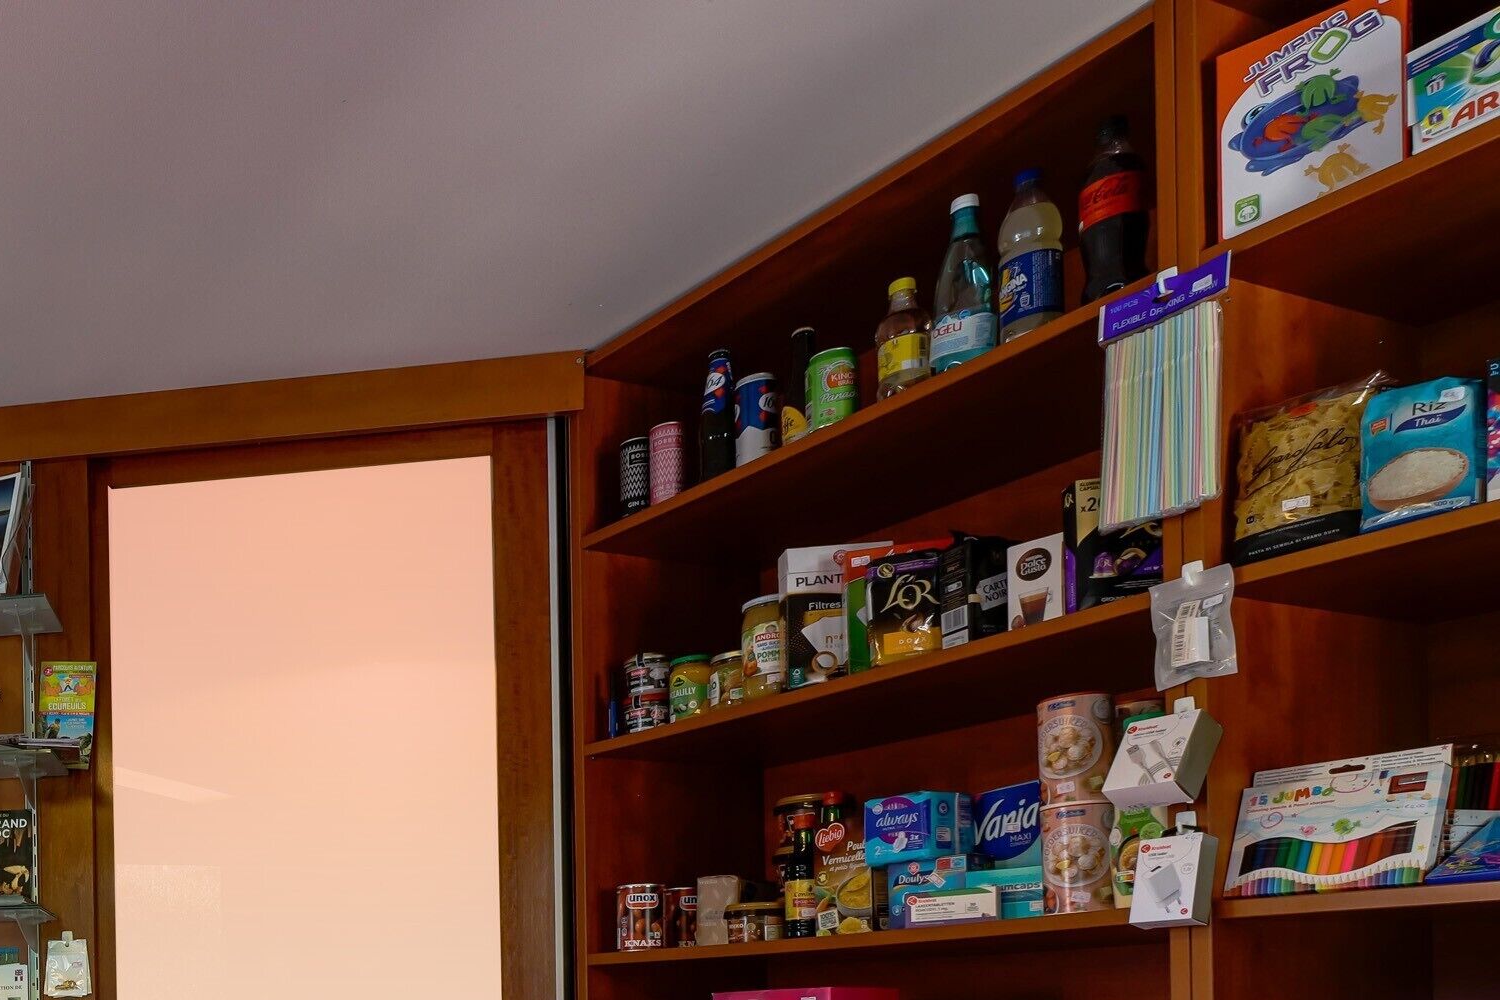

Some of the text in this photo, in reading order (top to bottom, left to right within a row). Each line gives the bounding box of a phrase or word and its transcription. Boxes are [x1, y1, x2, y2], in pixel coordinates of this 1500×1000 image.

[1245, 12, 1347, 81] JUMPING
[1257, 9, 1384, 97] FROG
[1112, 311, 1147, 331] FLEXIBLE
[1412, 402, 1447, 416] Riz
[1414, 415, 1442, 427] Thaï
[808, 601, 842, 611] Filtres
[1249, 786, 1334, 806] 15 JUMBO
[876, 811, 918, 828] always
[974, 799, 1040, 847] Vania
[819, 829, 842, 847] Liebig
[629, 893, 657, 903] unox
[624, 939, 662, 947] KNAKS
